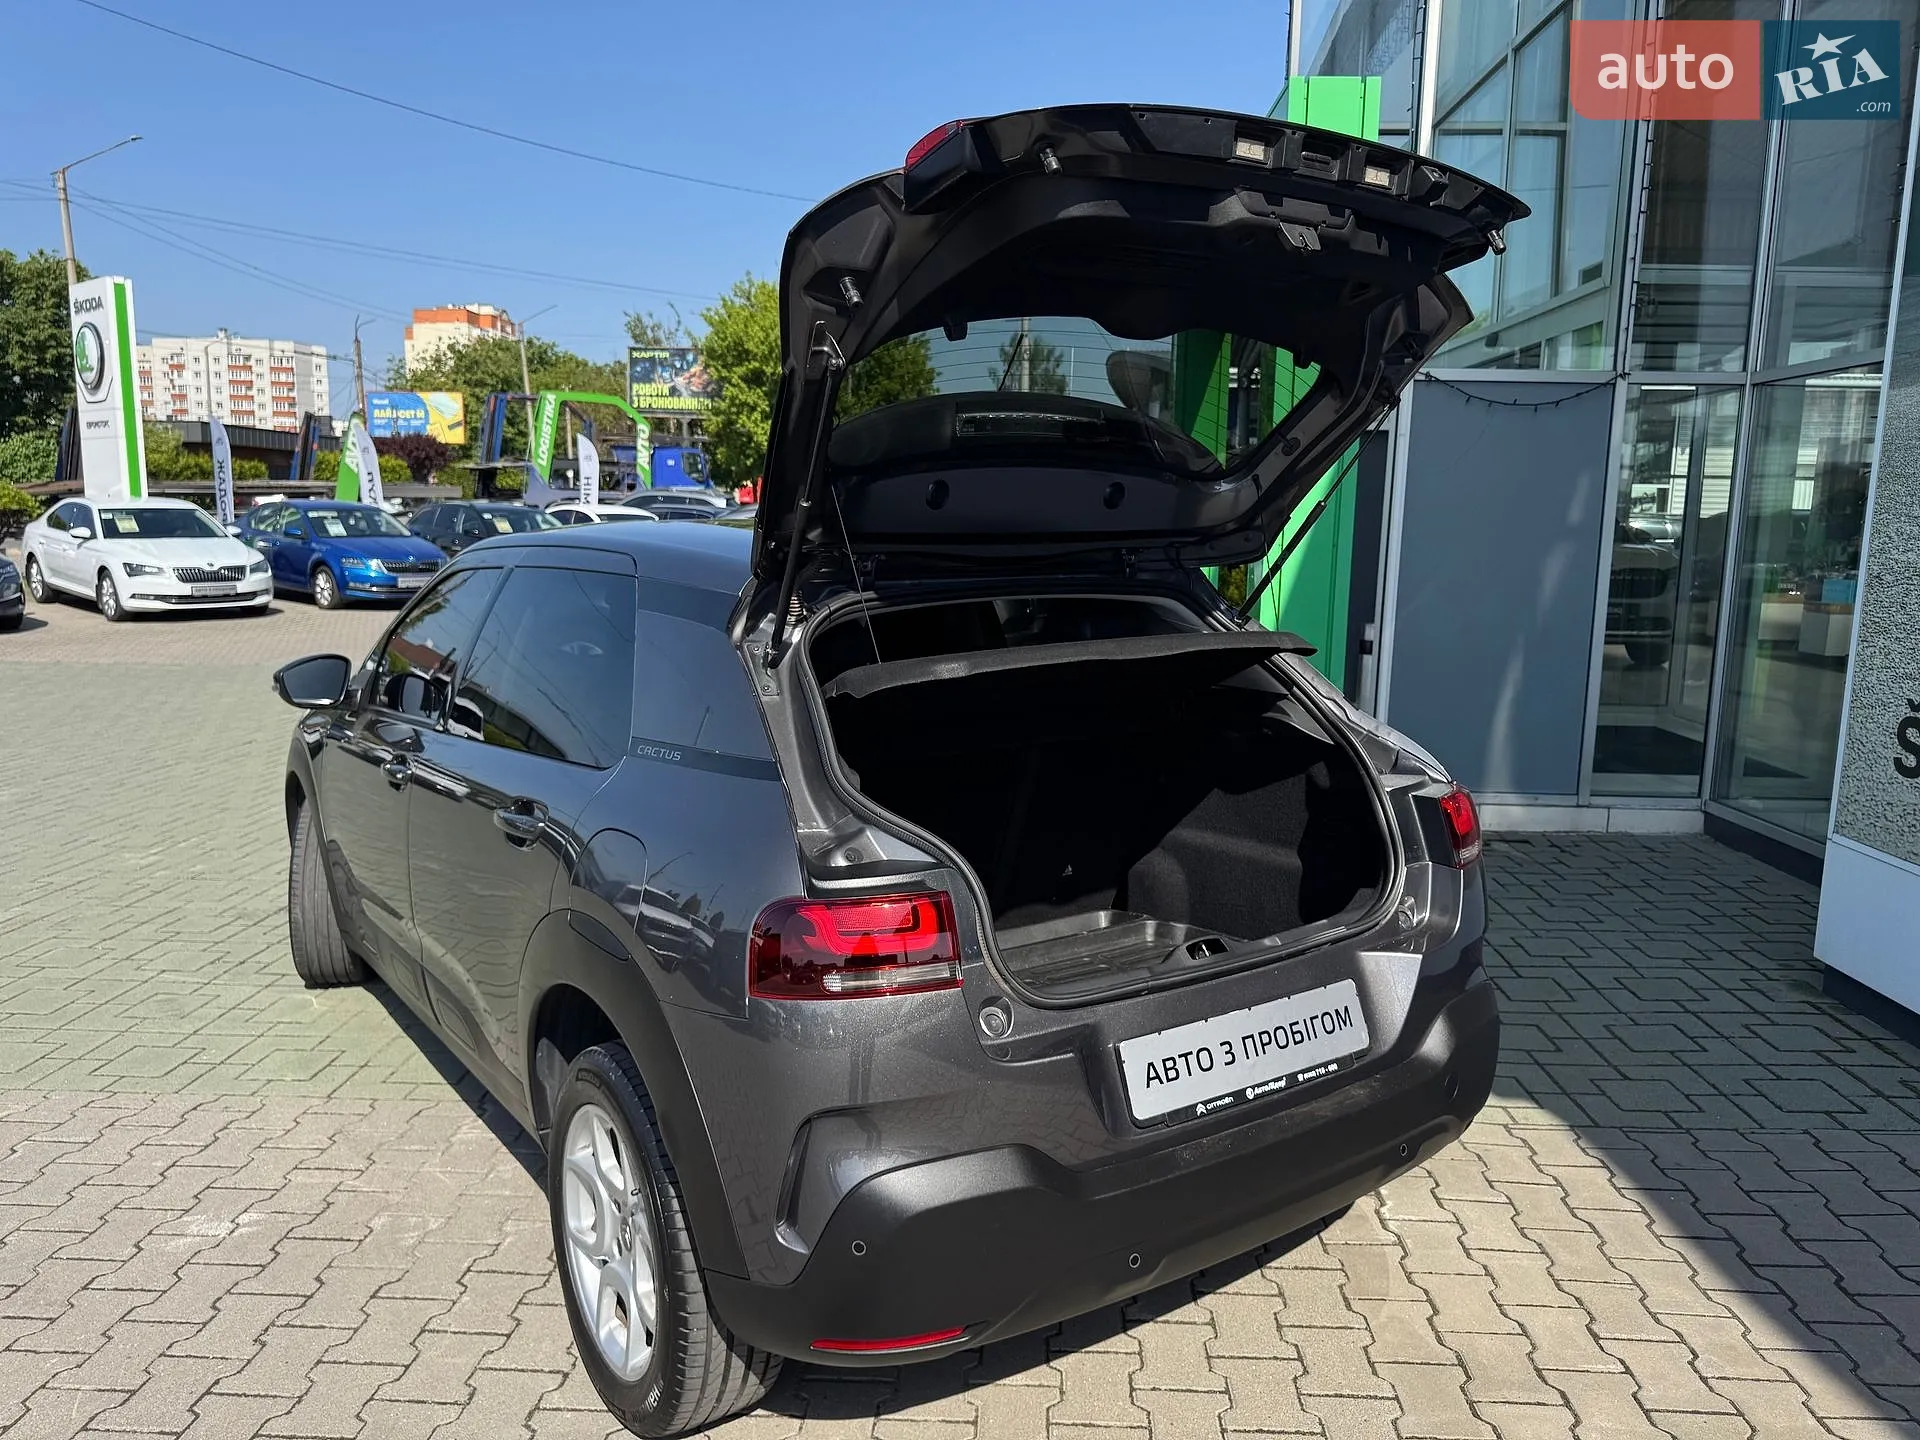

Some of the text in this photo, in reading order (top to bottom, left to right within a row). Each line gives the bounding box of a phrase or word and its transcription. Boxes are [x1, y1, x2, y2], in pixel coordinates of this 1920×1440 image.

[73, 296, 105, 316] ŠKODA
[632, 383, 670, 396] РОБОТА
[537, 393, 557, 467] LOGISTIKA
[637, 423, 650, 471] AVTO
[637, 744, 682, 761] CACTUS
[1145, 1046, 1214, 1089] АВТО
[1241, 1005, 1354, 1060] ПРОБІГОМ
